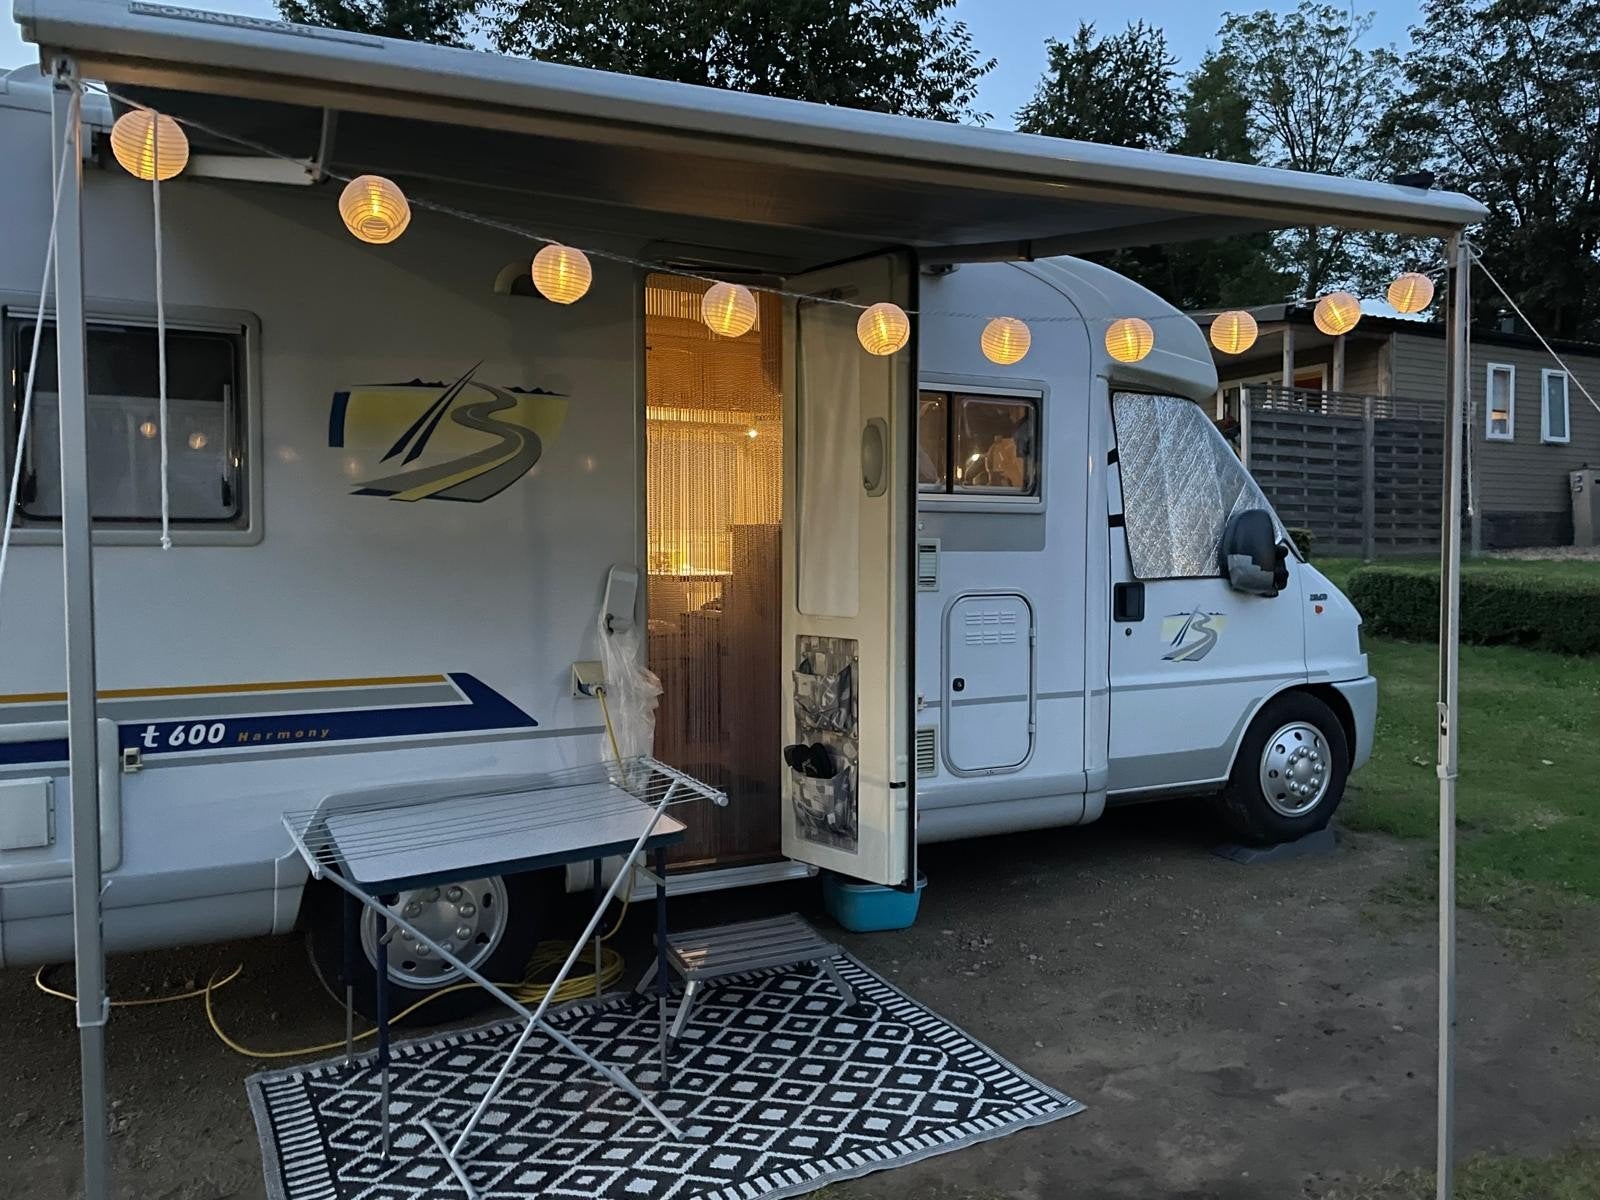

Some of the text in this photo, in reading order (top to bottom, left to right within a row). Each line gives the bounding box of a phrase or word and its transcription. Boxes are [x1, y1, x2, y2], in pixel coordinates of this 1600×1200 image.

[140, 723, 329, 748] t 600 Harmony
